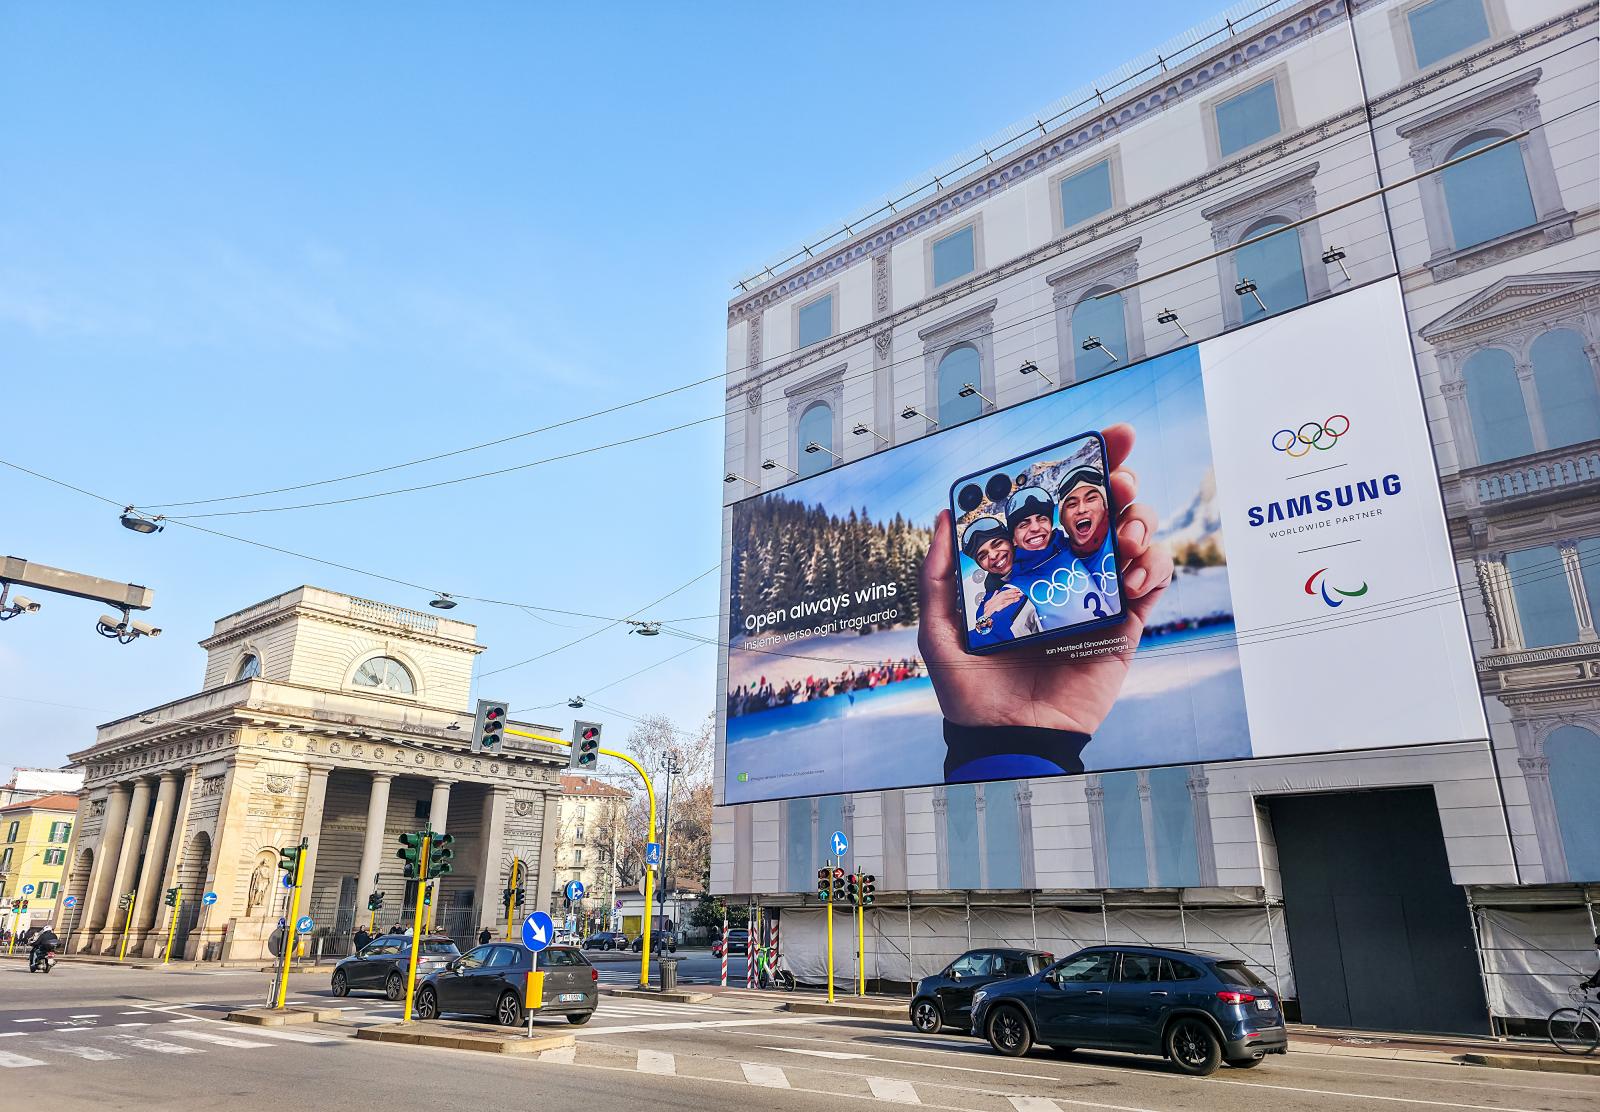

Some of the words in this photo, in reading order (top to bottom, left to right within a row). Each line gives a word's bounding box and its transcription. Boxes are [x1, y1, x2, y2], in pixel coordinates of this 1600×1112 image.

[1247, 474, 1402, 527] SAMSUNG
[1269, 519, 1331, 539] WORLDWIDE
[1335, 508, 1383, 525] PARTNER
[744, 608, 786, 632] Open
[790, 593, 850, 619] always
[855, 582, 897, 604] wins
[744, 634, 781, 651] Insieme
[783, 627, 812, 641] verso
[813, 622, 837, 637] ogni
[840, 608, 898, 630] traguardo
[1083, 635, 1128, 649] (Snowboard)
[1079, 649, 1093, 657] suoi
[1093, 644, 1129, 656] compagni
